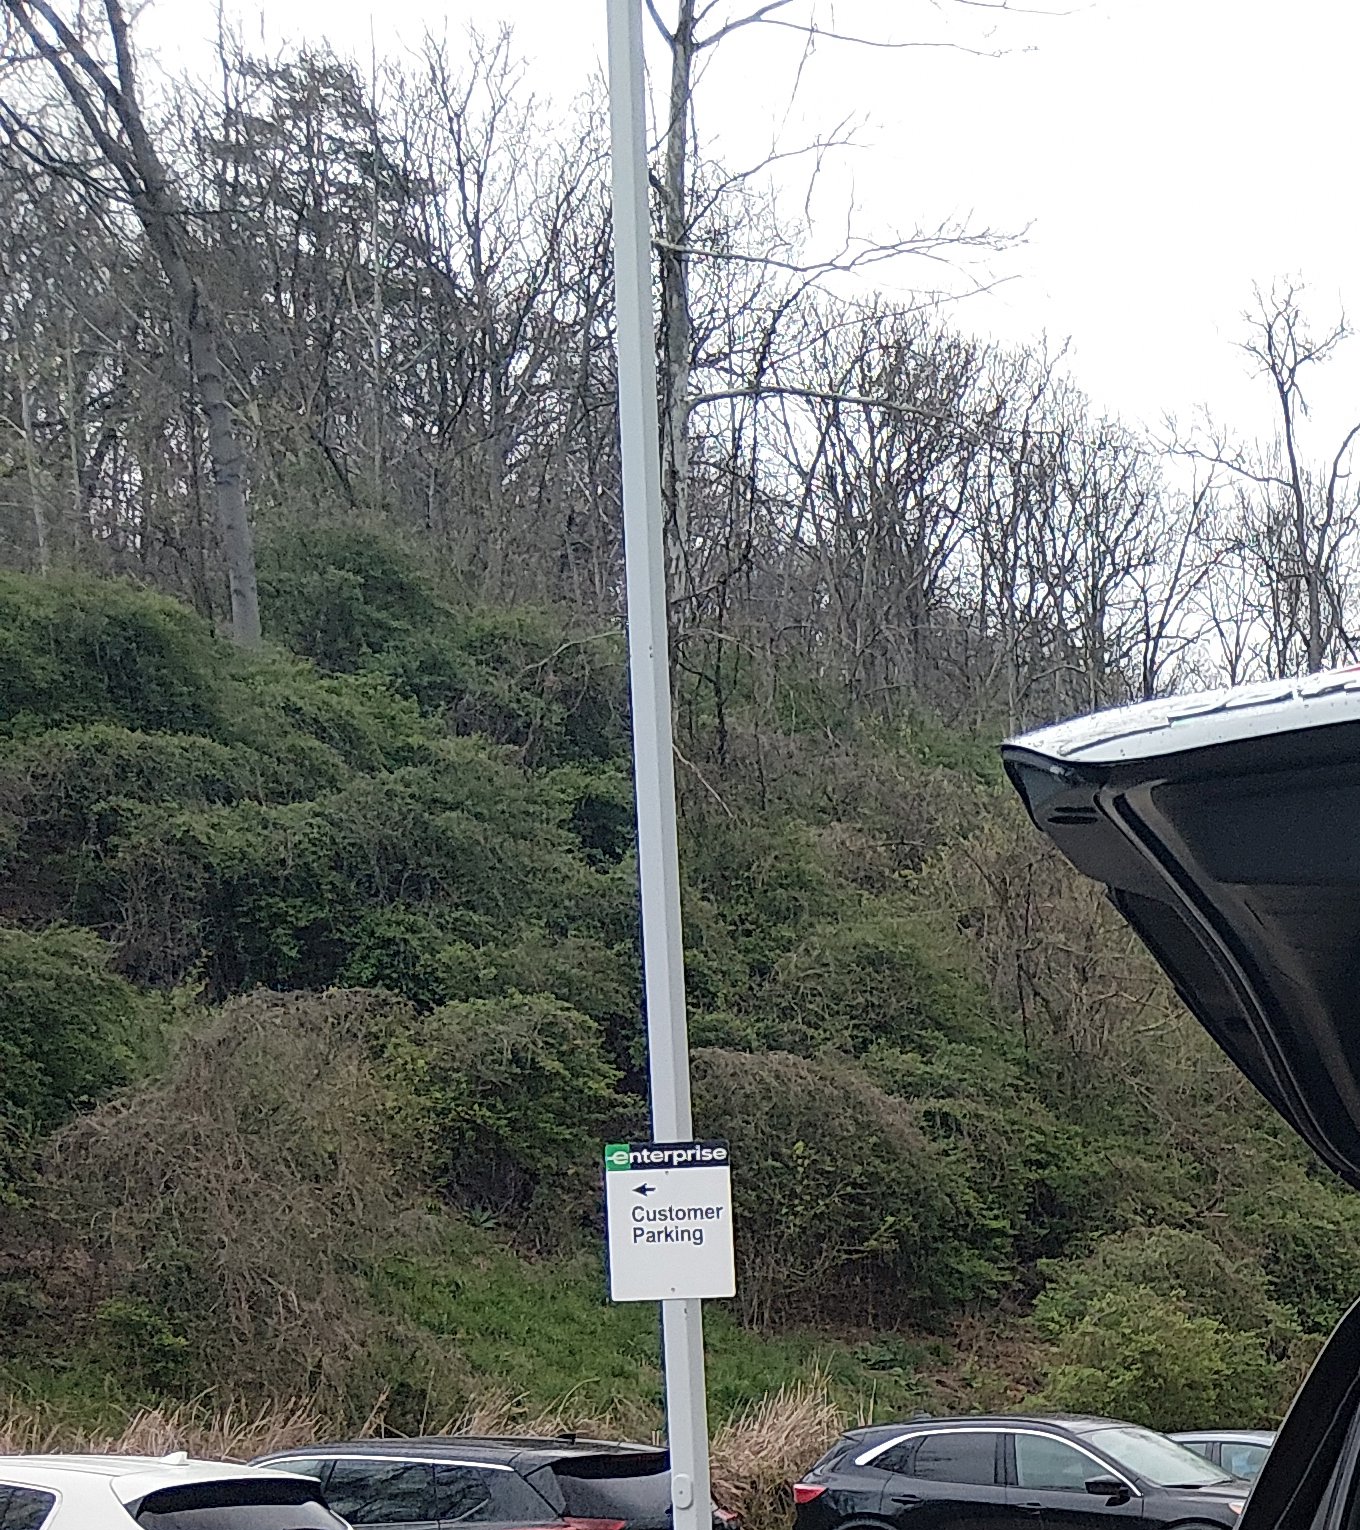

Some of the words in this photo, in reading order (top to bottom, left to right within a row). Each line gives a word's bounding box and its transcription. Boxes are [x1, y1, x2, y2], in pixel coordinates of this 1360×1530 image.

[607, 1144, 728, 1166] enterprise
[631, 1204, 724, 1223] Customer
[633, 1225, 704, 1246] Parking
